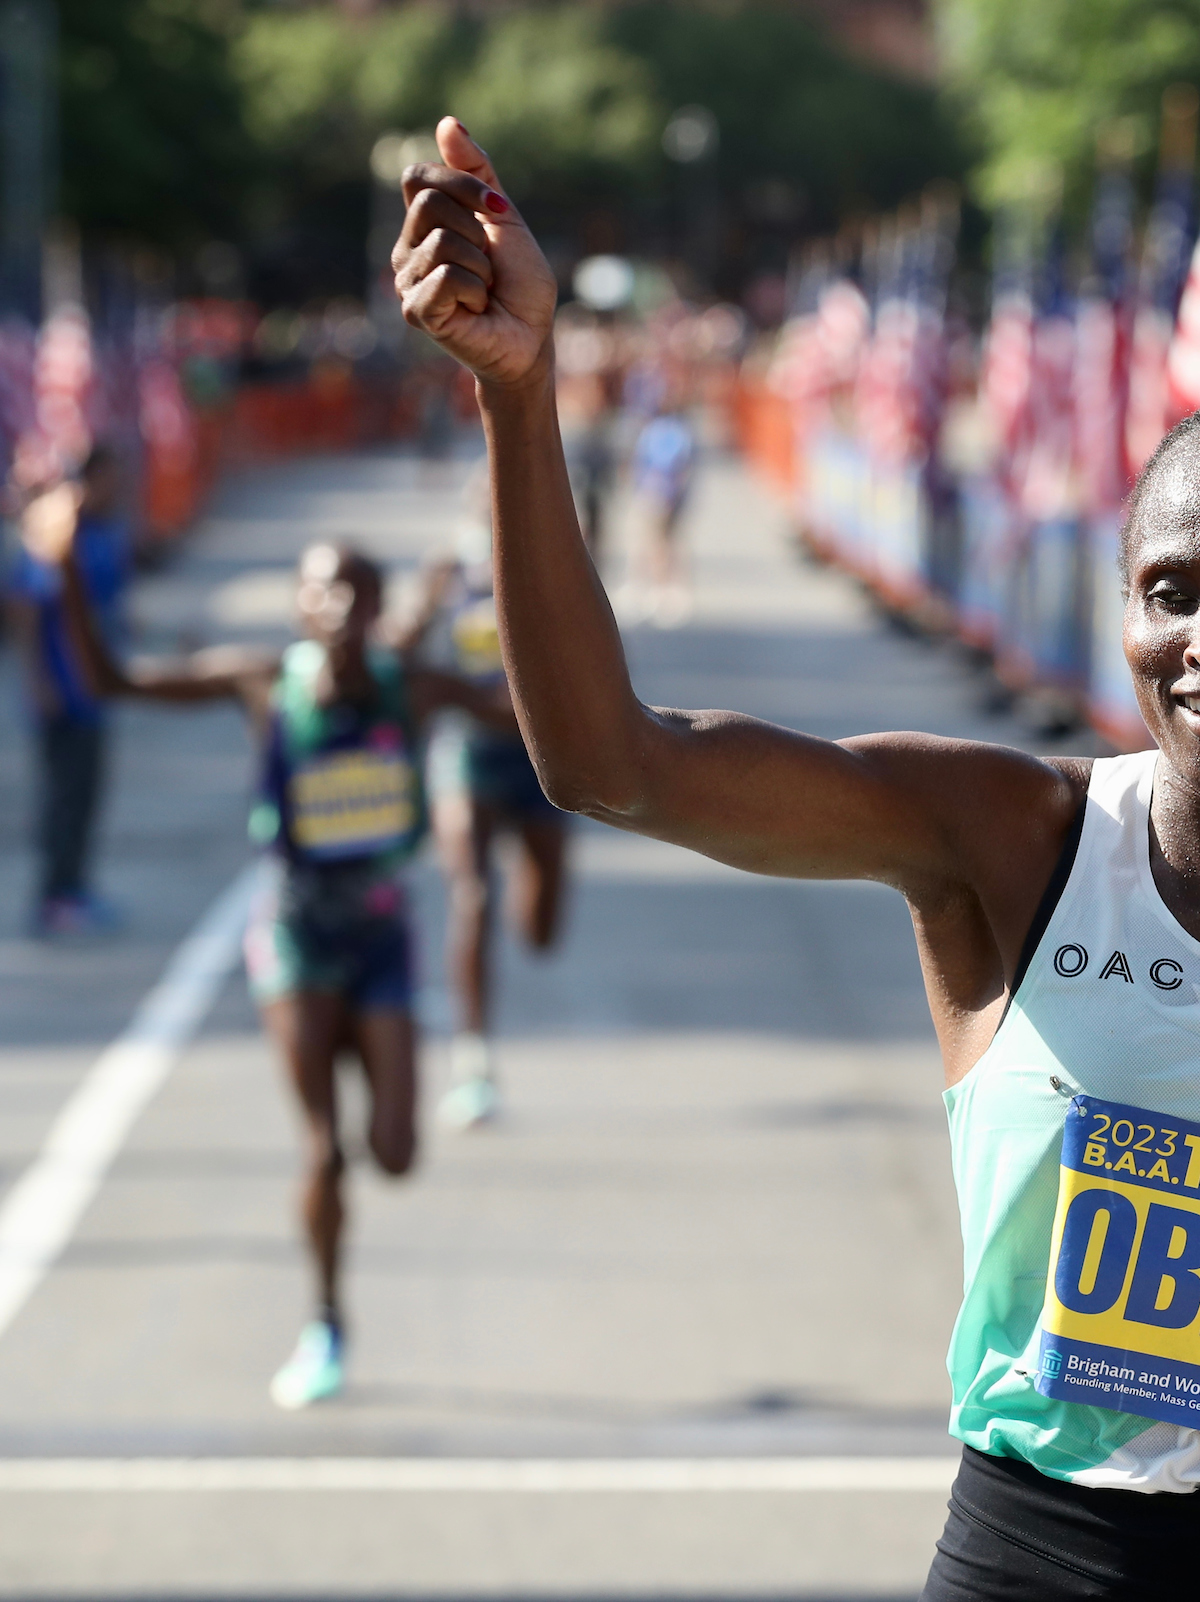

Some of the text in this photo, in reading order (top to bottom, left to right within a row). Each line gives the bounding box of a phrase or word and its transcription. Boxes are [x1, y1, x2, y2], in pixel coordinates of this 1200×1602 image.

[1054, 942, 1184, 991] OAC
[1088, 1114, 1179, 1157] 2023
[1082, 1141, 1179, 1185] B.A.A.
[1064, 1373, 1112, 1392] Founding
[1113, 1383, 1158, 1401] Member,
[1160, 1392, 1187, 1407] Mass
[1067, 1354, 1135, 1381] Brigham
[1138, 1371, 1171, 1388] and
